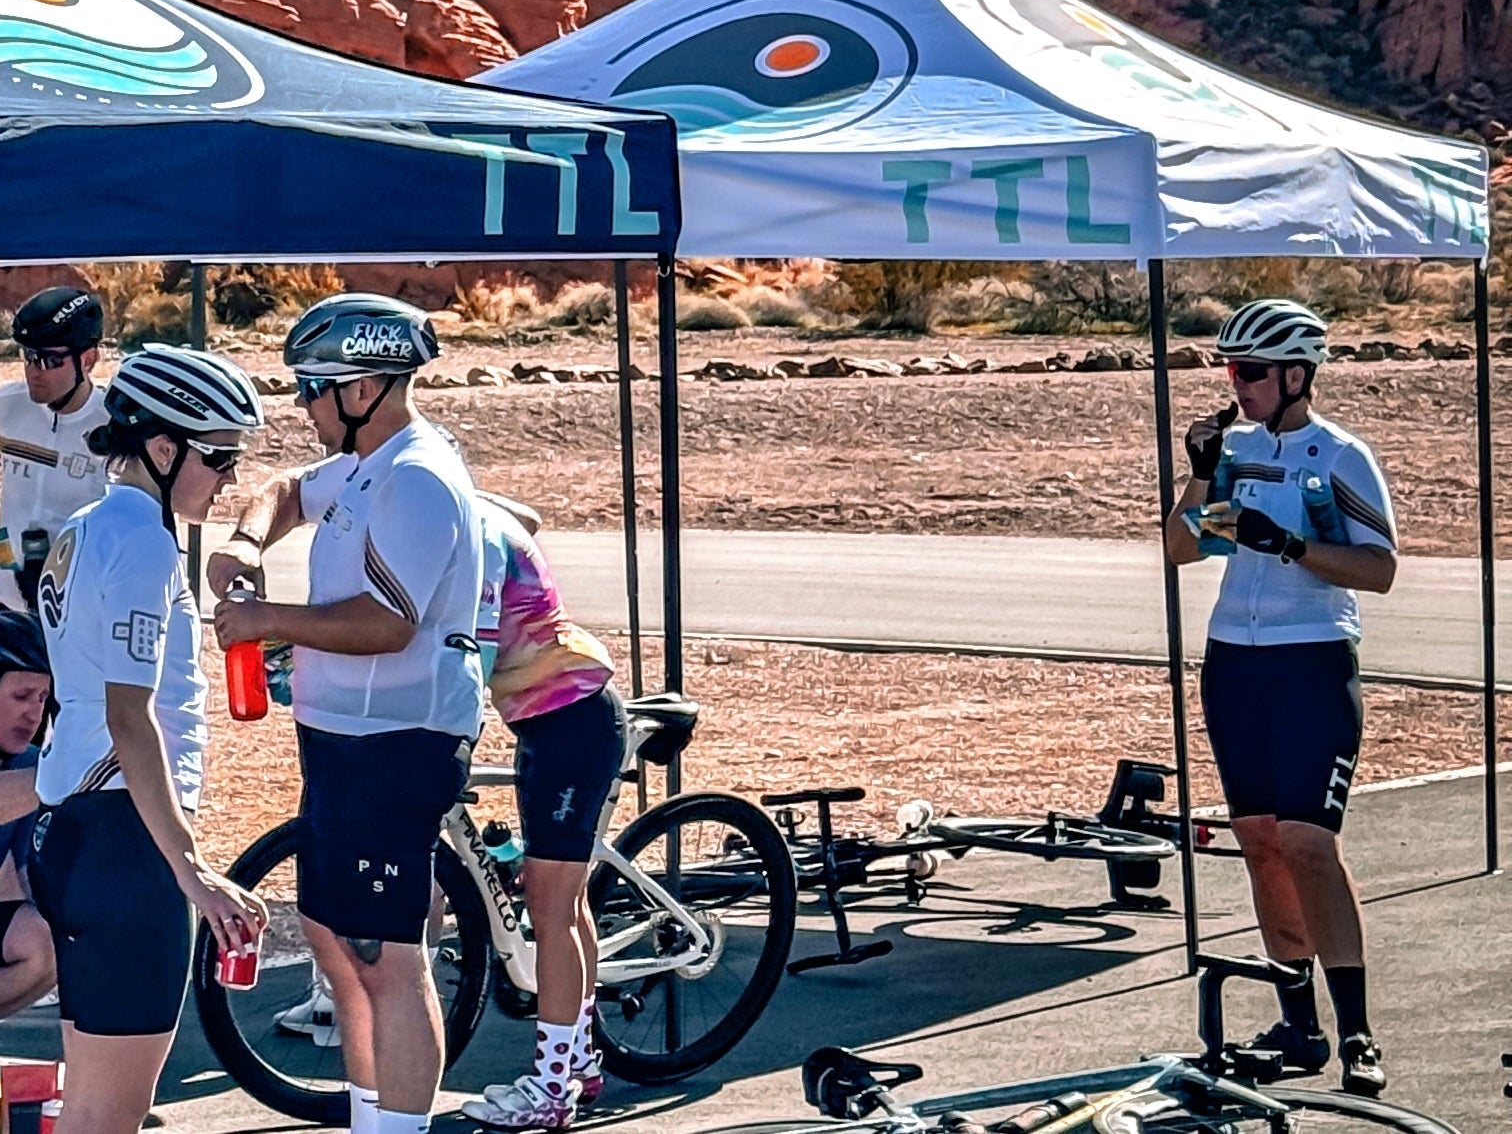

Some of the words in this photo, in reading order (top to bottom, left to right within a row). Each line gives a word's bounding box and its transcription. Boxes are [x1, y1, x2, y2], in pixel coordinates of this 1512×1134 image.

[451, 131, 660, 236] TTL
[882, 154, 1131, 245] TTL
[341, 336, 413, 359] CANCER
[353, 322, 403, 342] FUCK
[168, 387, 210, 413] LAZER
[1324, 753, 1357, 811] TTL
